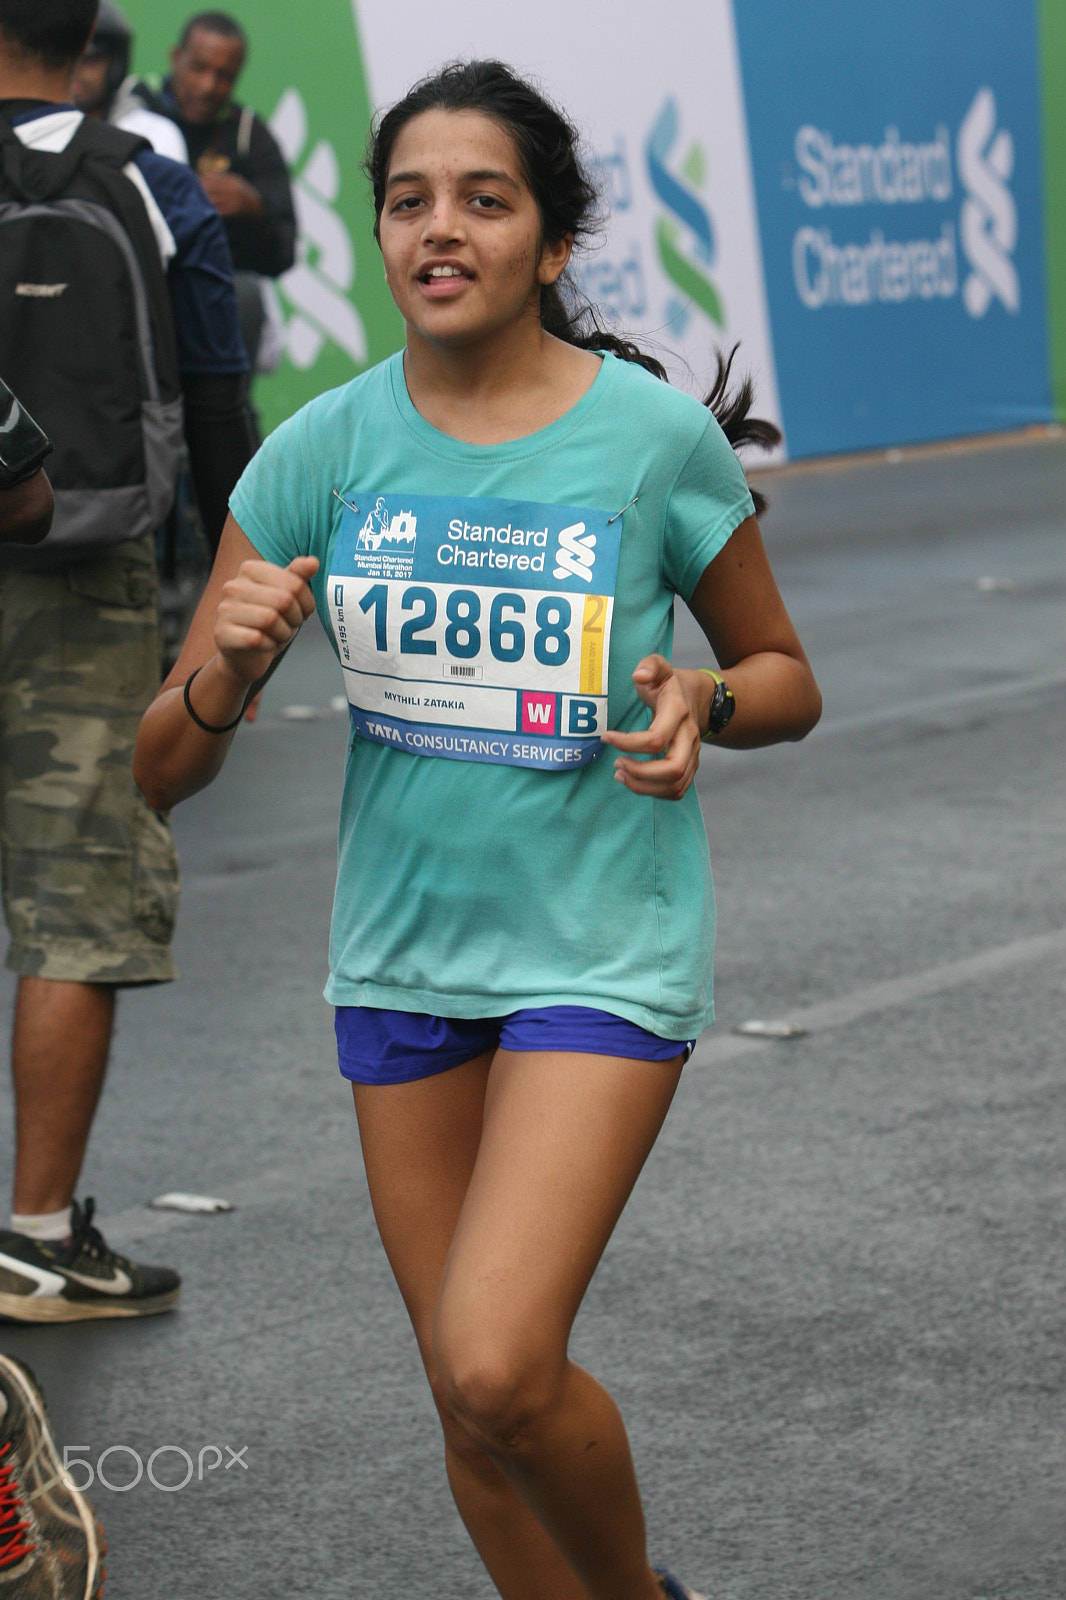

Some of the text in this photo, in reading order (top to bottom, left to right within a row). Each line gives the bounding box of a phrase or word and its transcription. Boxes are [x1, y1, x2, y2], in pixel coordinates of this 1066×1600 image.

[795, 124, 953, 207] Standard
[791, 222, 957, 309] Chartered
[447, 520, 548, 547] Standard
[354, 553, 414, 564] Standard Chartered
[357, 561, 413, 572] Mumbai Marathon
[437, 544, 545, 572] Chartered
[367, 569, 380, 577] Jan
[394, 571, 412, 579] 2017
[337, 608, 344, 623] km
[358, 583, 572, 667] 12868
[584, 595, 604, 634] 2
[384, 691, 465, 711] MYTHILI ZATAKIA
[527, 702, 552, 724] W
[568, 700, 598, 734] B
[365, 721, 582, 762] TATA CONSULTANCY SERVICES
